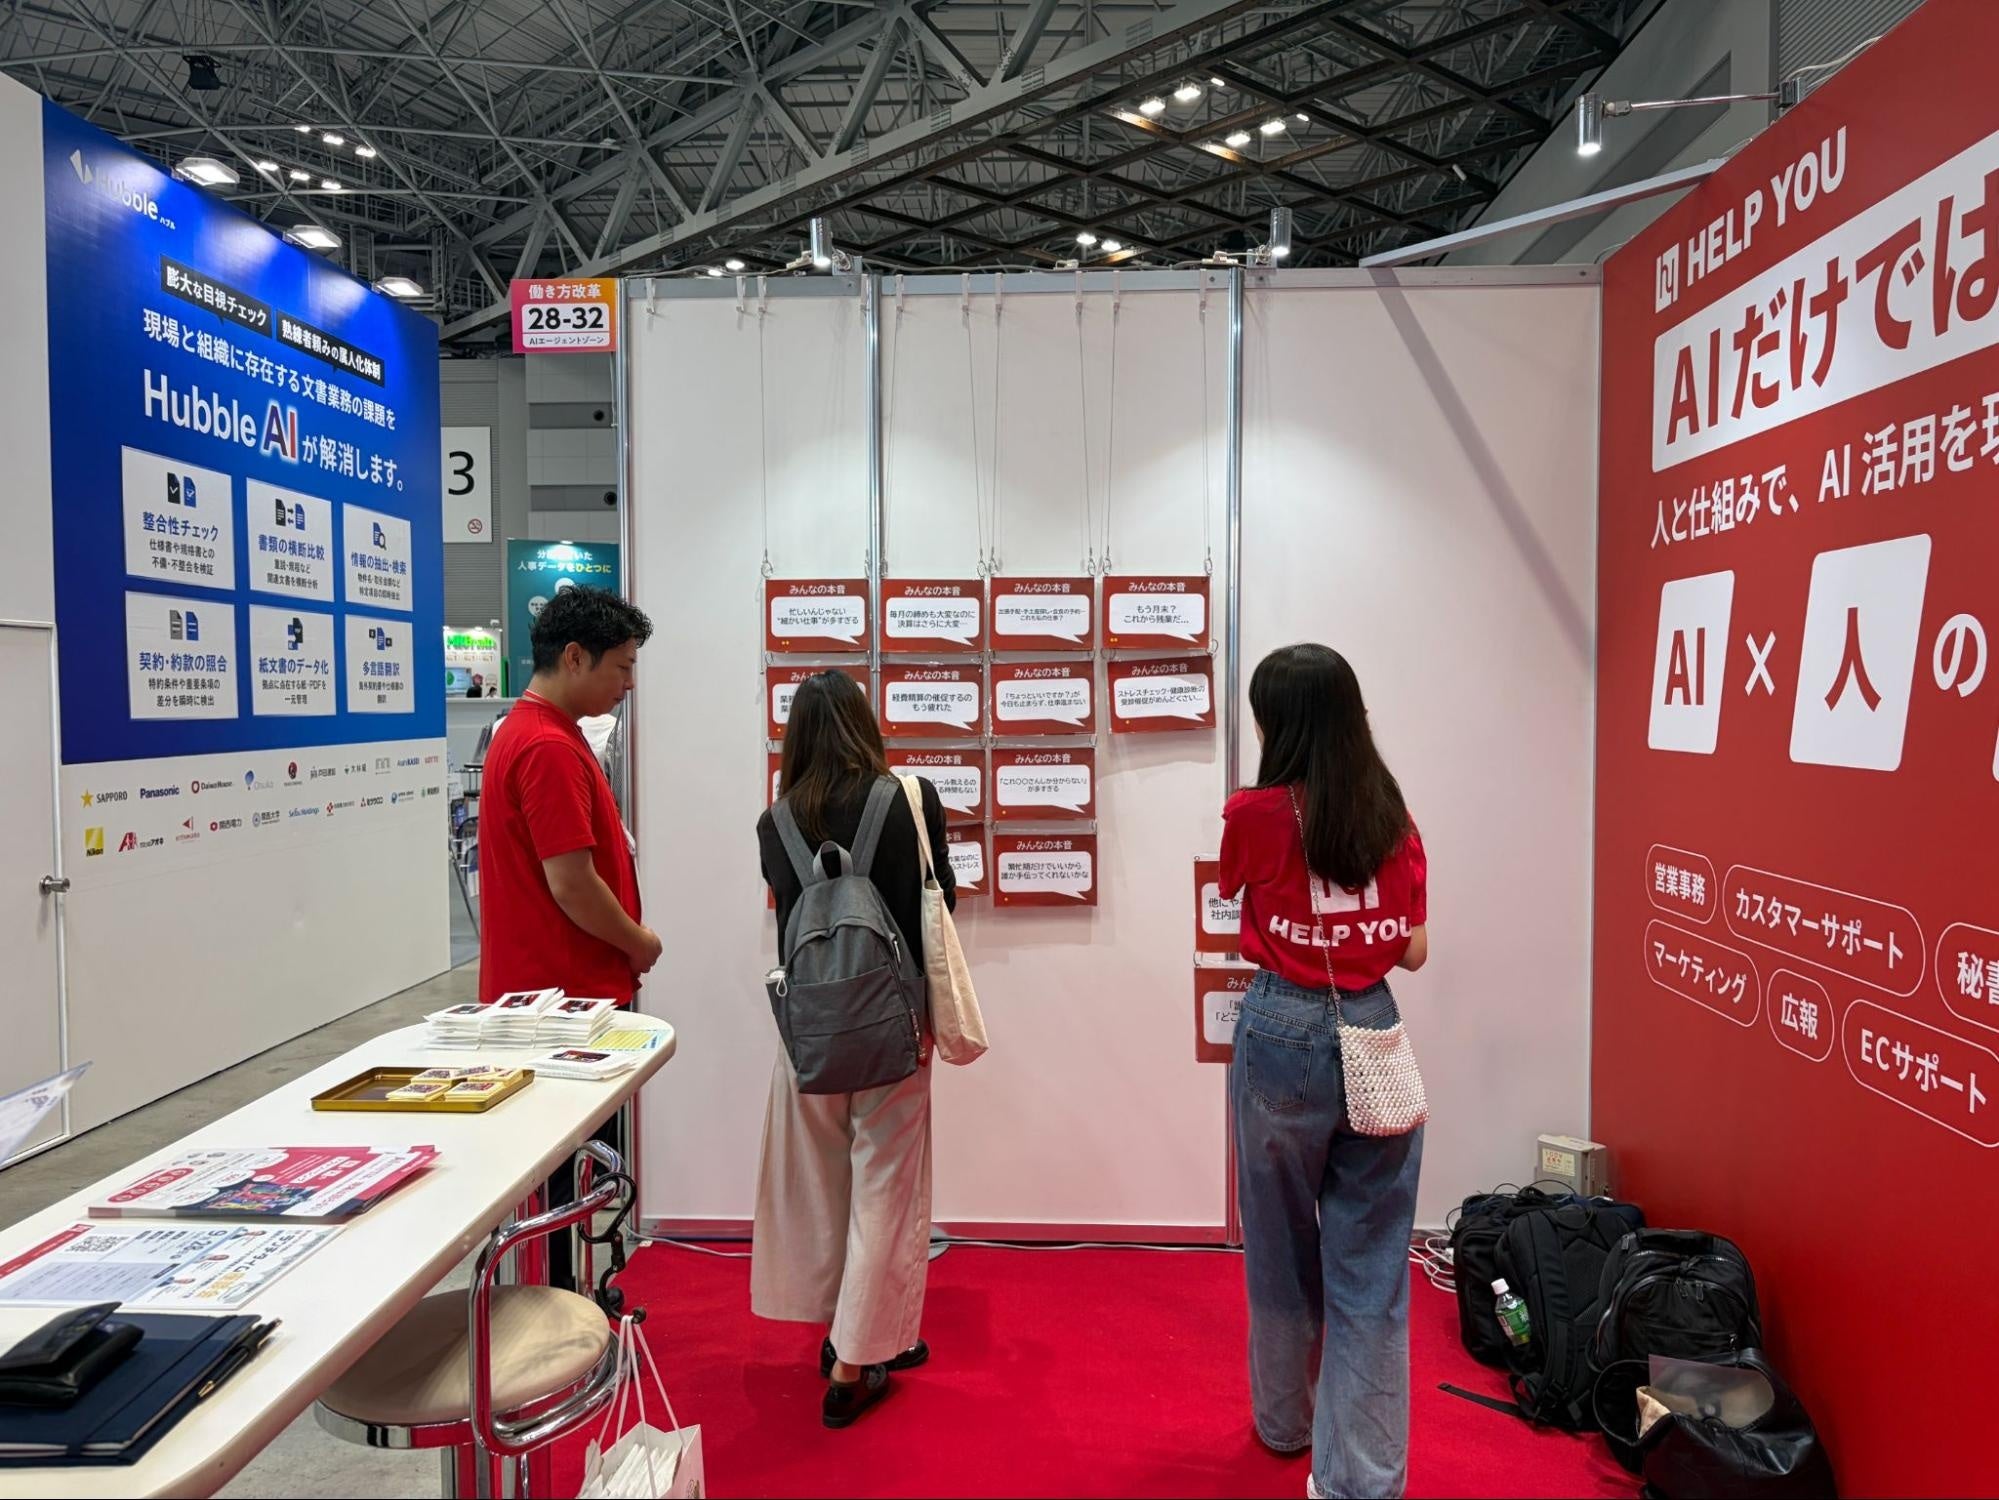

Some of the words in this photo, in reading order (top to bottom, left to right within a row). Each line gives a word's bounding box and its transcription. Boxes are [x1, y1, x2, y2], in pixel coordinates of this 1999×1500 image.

[1687, 190, 1763, 287] HELP
[1770, 125, 1847, 227] YOU
[159, 216, 176, 230] ハブル
[166, 265, 268, 327] 膨大な目視チェック
[528, 283, 602, 299] 働き方改革
[1666, 168, 1999, 446] AIだけでは
[527, 306, 605, 331] 28-32
[529, 335, 605, 345] AIエージェントゾーン
[281, 319, 381, 380] 熟練者頼みの属人化体制
[142, 308, 396, 430] 現場と組織に存在する文書業務の課題を
[142, 368, 257, 449] Hubble
[262, 404, 297, 459] AI
[302, 437, 405, 492] が解消します。
[447, 451, 476, 496] 3
[1650, 464, 1800, 549] 人と仕組みで、
[1818, 444, 1851, 503] AI
[143, 511, 218, 541] 整合性チェック
[258, 534, 325, 561] 書類の横断比較
[351, 552, 407, 576] 情報の抽出・検索
[517, 561, 612, 574] 人事データをひとつに
[789, 584, 846, 595] みんなの本音
[904, 586, 961, 596] みんなの本音
[1014, 583, 1071, 593] みんなの本音
[1128, 582, 1186, 592] みんなの本音
[788, 608, 847, 616] 忙しいんじゃない
[889, 610, 976, 619] 毎月の締めも大変なのに
[139, 652, 227, 672] 契約・約款の照合
[259, 656, 329, 674] 紙文書のデータ化
[1664, 626, 1706, 705] AI
[1824, 607, 1882, 712] 人
[1933, 613, 1987, 698] の
[362, 661, 400, 676] 多言語翻訳
[904, 670, 961, 681] みんなの本音
[1014, 667, 1071, 678] みんなの本音
[1131, 663, 1190, 676] みんなの本音
[892, 693, 973, 703] 経費精算の催促するの
[912, 703, 952, 712] もう疲れた
[906, 754, 962, 765] みんなの本音
[1015, 753, 1072, 763] みんなの本音
[139, 784, 180, 799] Panasonic
[1027, 785, 1060, 793] が多すぎる
[96, 790, 128, 804] SAPPORO
[86, 848, 105, 857] Nikon
[1016, 840, 1073, 850] みんなの本音
[1007, 863, 1082, 871] 繁忙期だけでいいから
[1001, 871, 1089, 880] 誰か手伝ってくれないかな
[1654, 862, 1706, 907] 営業事務
[1268, 914, 1351, 948] HELP
[1736, 887, 1904, 970] カスタマーサポート
[1653, 940, 1748, 1004] マーケティング
[1780, 992, 1818, 1041] 広報
[1860, 1027, 1987, 1114] ECサポート
